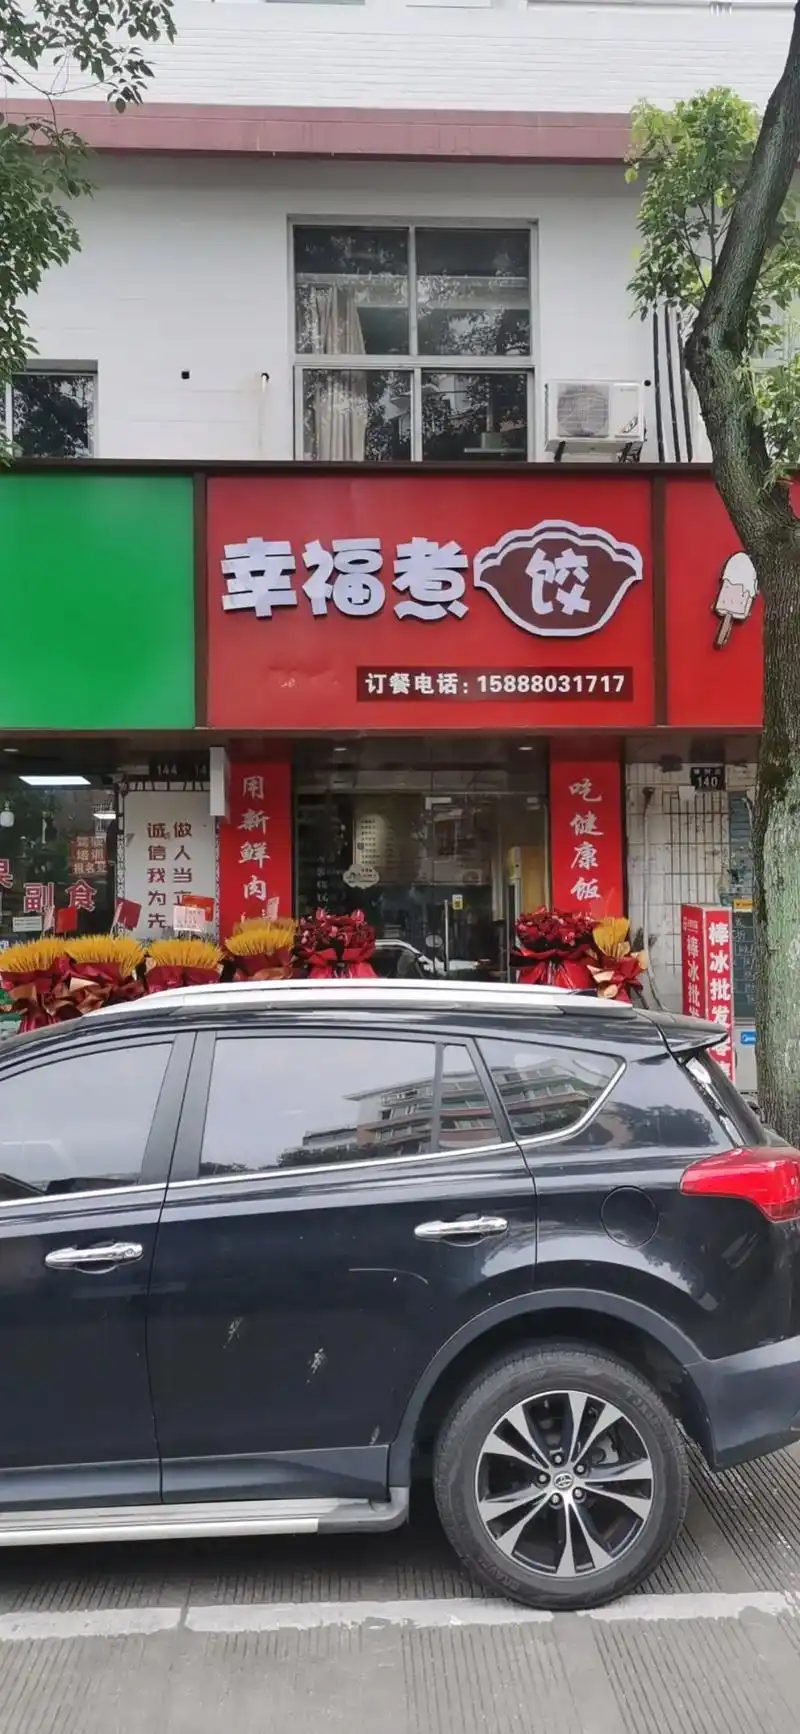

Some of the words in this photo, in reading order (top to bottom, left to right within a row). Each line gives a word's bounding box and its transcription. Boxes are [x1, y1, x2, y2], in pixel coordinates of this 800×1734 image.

[237, 775, 270, 921] 用新鲜肉
[568, 778, 604, 921] 吃健康饭
[697, 776, 718, 788] 140
